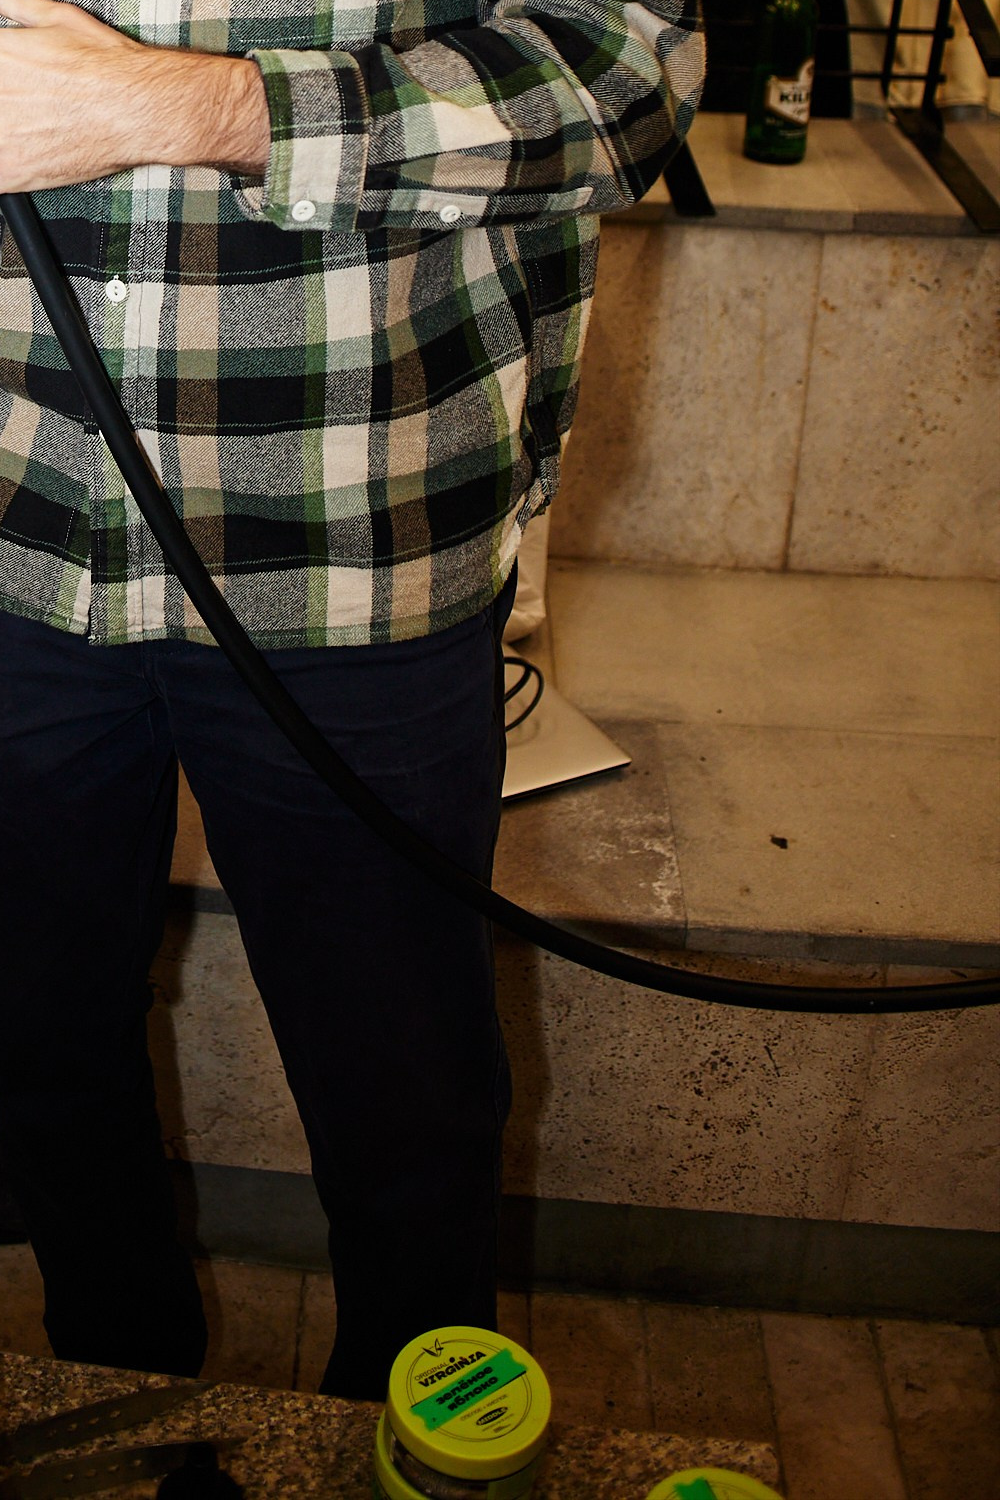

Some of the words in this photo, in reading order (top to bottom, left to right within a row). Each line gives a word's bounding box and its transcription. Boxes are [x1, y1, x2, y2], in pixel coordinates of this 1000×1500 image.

[414, 1361, 448, 1381] ORIGINAL
[418, 1351, 487, 1388] VIRGINIA
[435, 1366, 494, 1405] зелёное
[447, 1376, 498, 1411] яблоко
